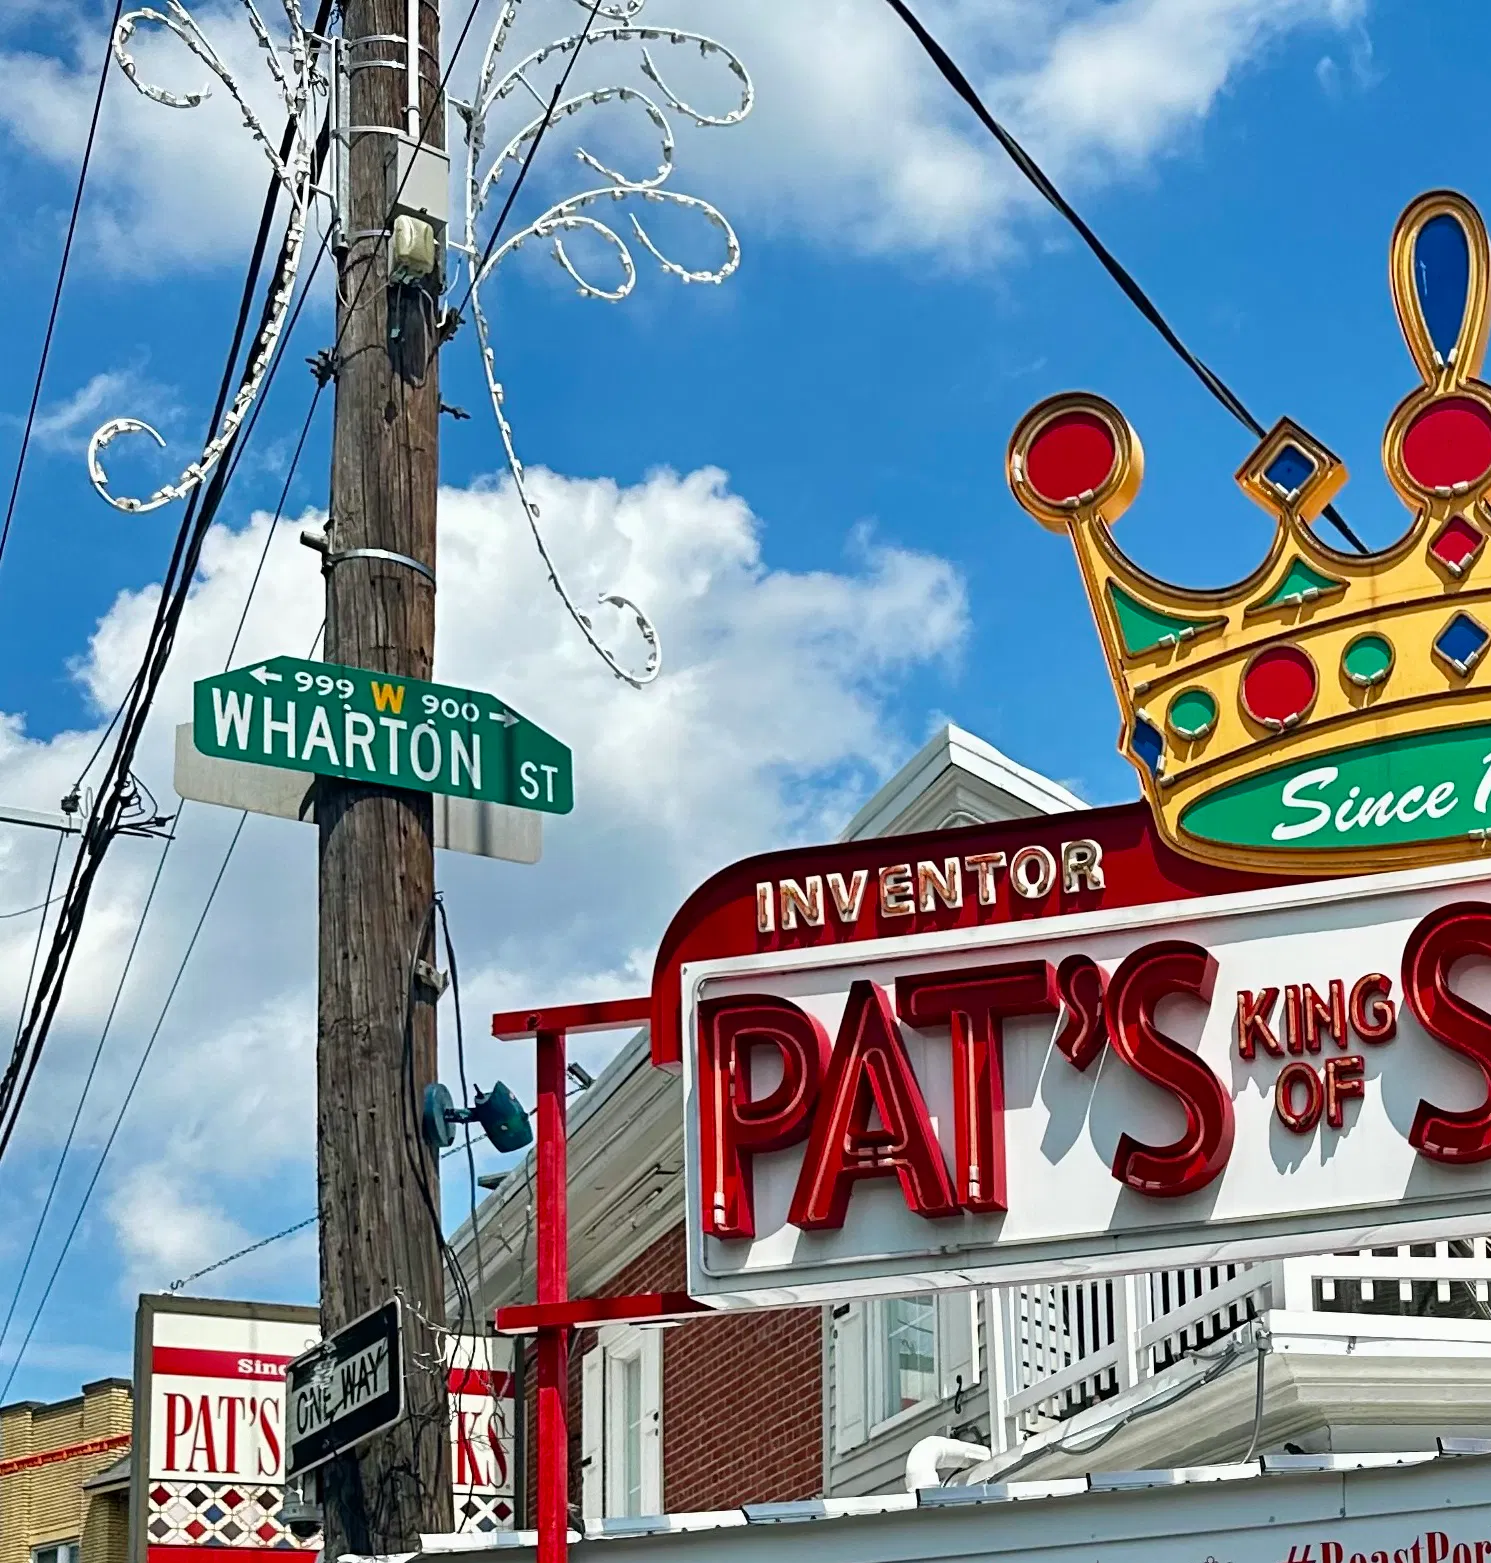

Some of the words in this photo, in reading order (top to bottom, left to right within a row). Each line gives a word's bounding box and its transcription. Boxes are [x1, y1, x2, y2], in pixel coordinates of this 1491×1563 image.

[294, 671, 355, 700] 999
[371, 681, 405, 714] W
[422, 694, 480, 722] 900
[212, 687, 482, 790] WHARTON
[520, 761, 559, 802] ST
[1271, 766, 1459, 842] Since
[755, 838, 1106, 934] INVENTOR
[1235, 972, 1398, 1060] KING
[697, 940, 1236, 1241] PAT'S
[1273, 1055, 1366, 1137] OF
[341, 1345, 383, 1410] WAY
[162, 1392, 281, 1477] PAT'S
